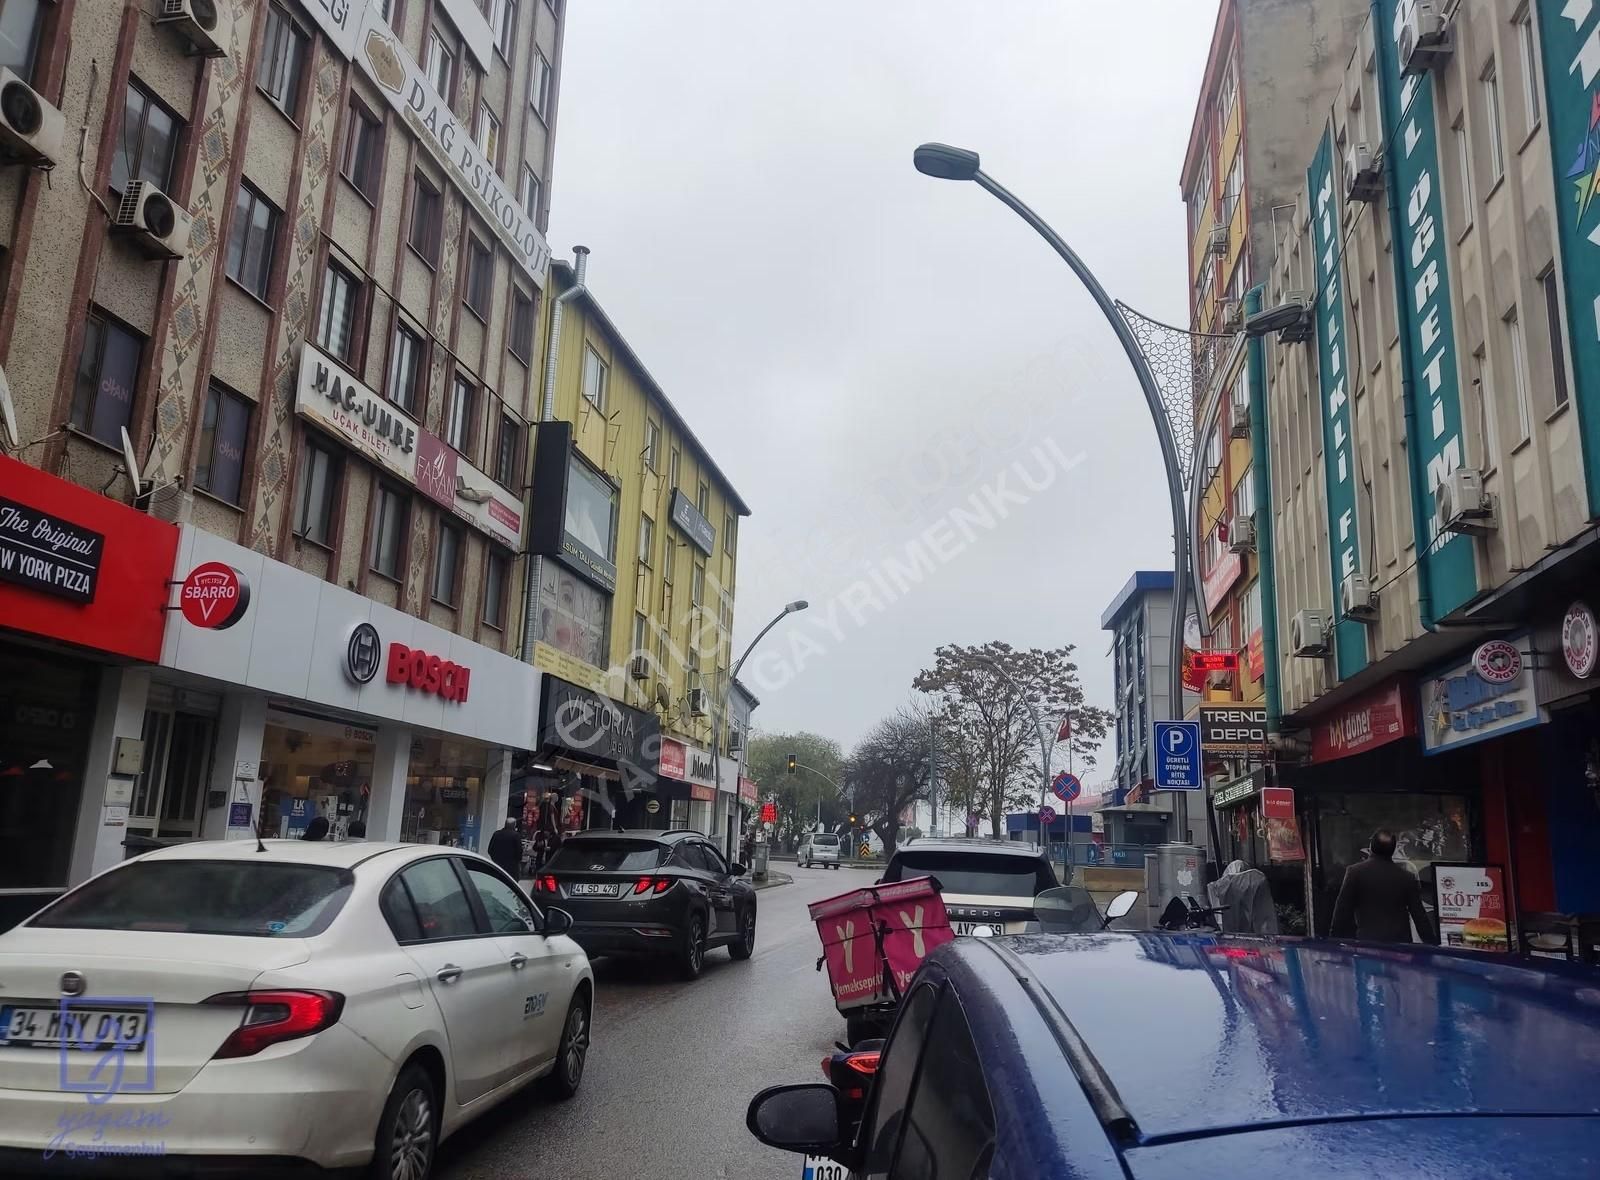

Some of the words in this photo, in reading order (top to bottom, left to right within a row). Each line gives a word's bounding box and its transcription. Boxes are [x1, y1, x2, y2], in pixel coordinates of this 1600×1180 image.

[407, 78, 456, 154] DAĞ
[458, 146, 551, 276] PSİKOLOJİ
[1317, 169, 1347, 485] NİTELİKLİ
[332, 409, 359, 434] UÇAK
[361, 428, 391, 456] BİLETİ
[0, 506, 29, 533] The
[31, 518, 97, 556] Original
[19, 553, 52, 583] YORK
[55, 565, 91, 594] PIZZA
[184, 585, 236, 600] SBARRO
[1564, 607, 1591, 641] SALOON
[1480, 643, 1519, 662] SALOON
[1566, 634, 1592, 670] BURGER
[385, 642, 470, 703] BOSCH
[1480, 660, 1521, 680] BURGER
[568, 691, 634, 740] VICTORIA
[1203, 711, 1267, 722] TREND
[1345, 707, 1372, 741] döner
[1169, 730, 1184, 752] P
[1210, 728, 1264, 740] DEPO
[1166, 756, 1190, 764] ÜCRETLİ
[1170, 771, 1186, 779] BİTİŞ
[575, 884, 584, 892] 41
[587, 884, 600, 893] SD
[602, 885, 618, 894] 478
[1442, 890, 1501, 909] KÖFTE
[11, 1011, 37, 1037] 34
